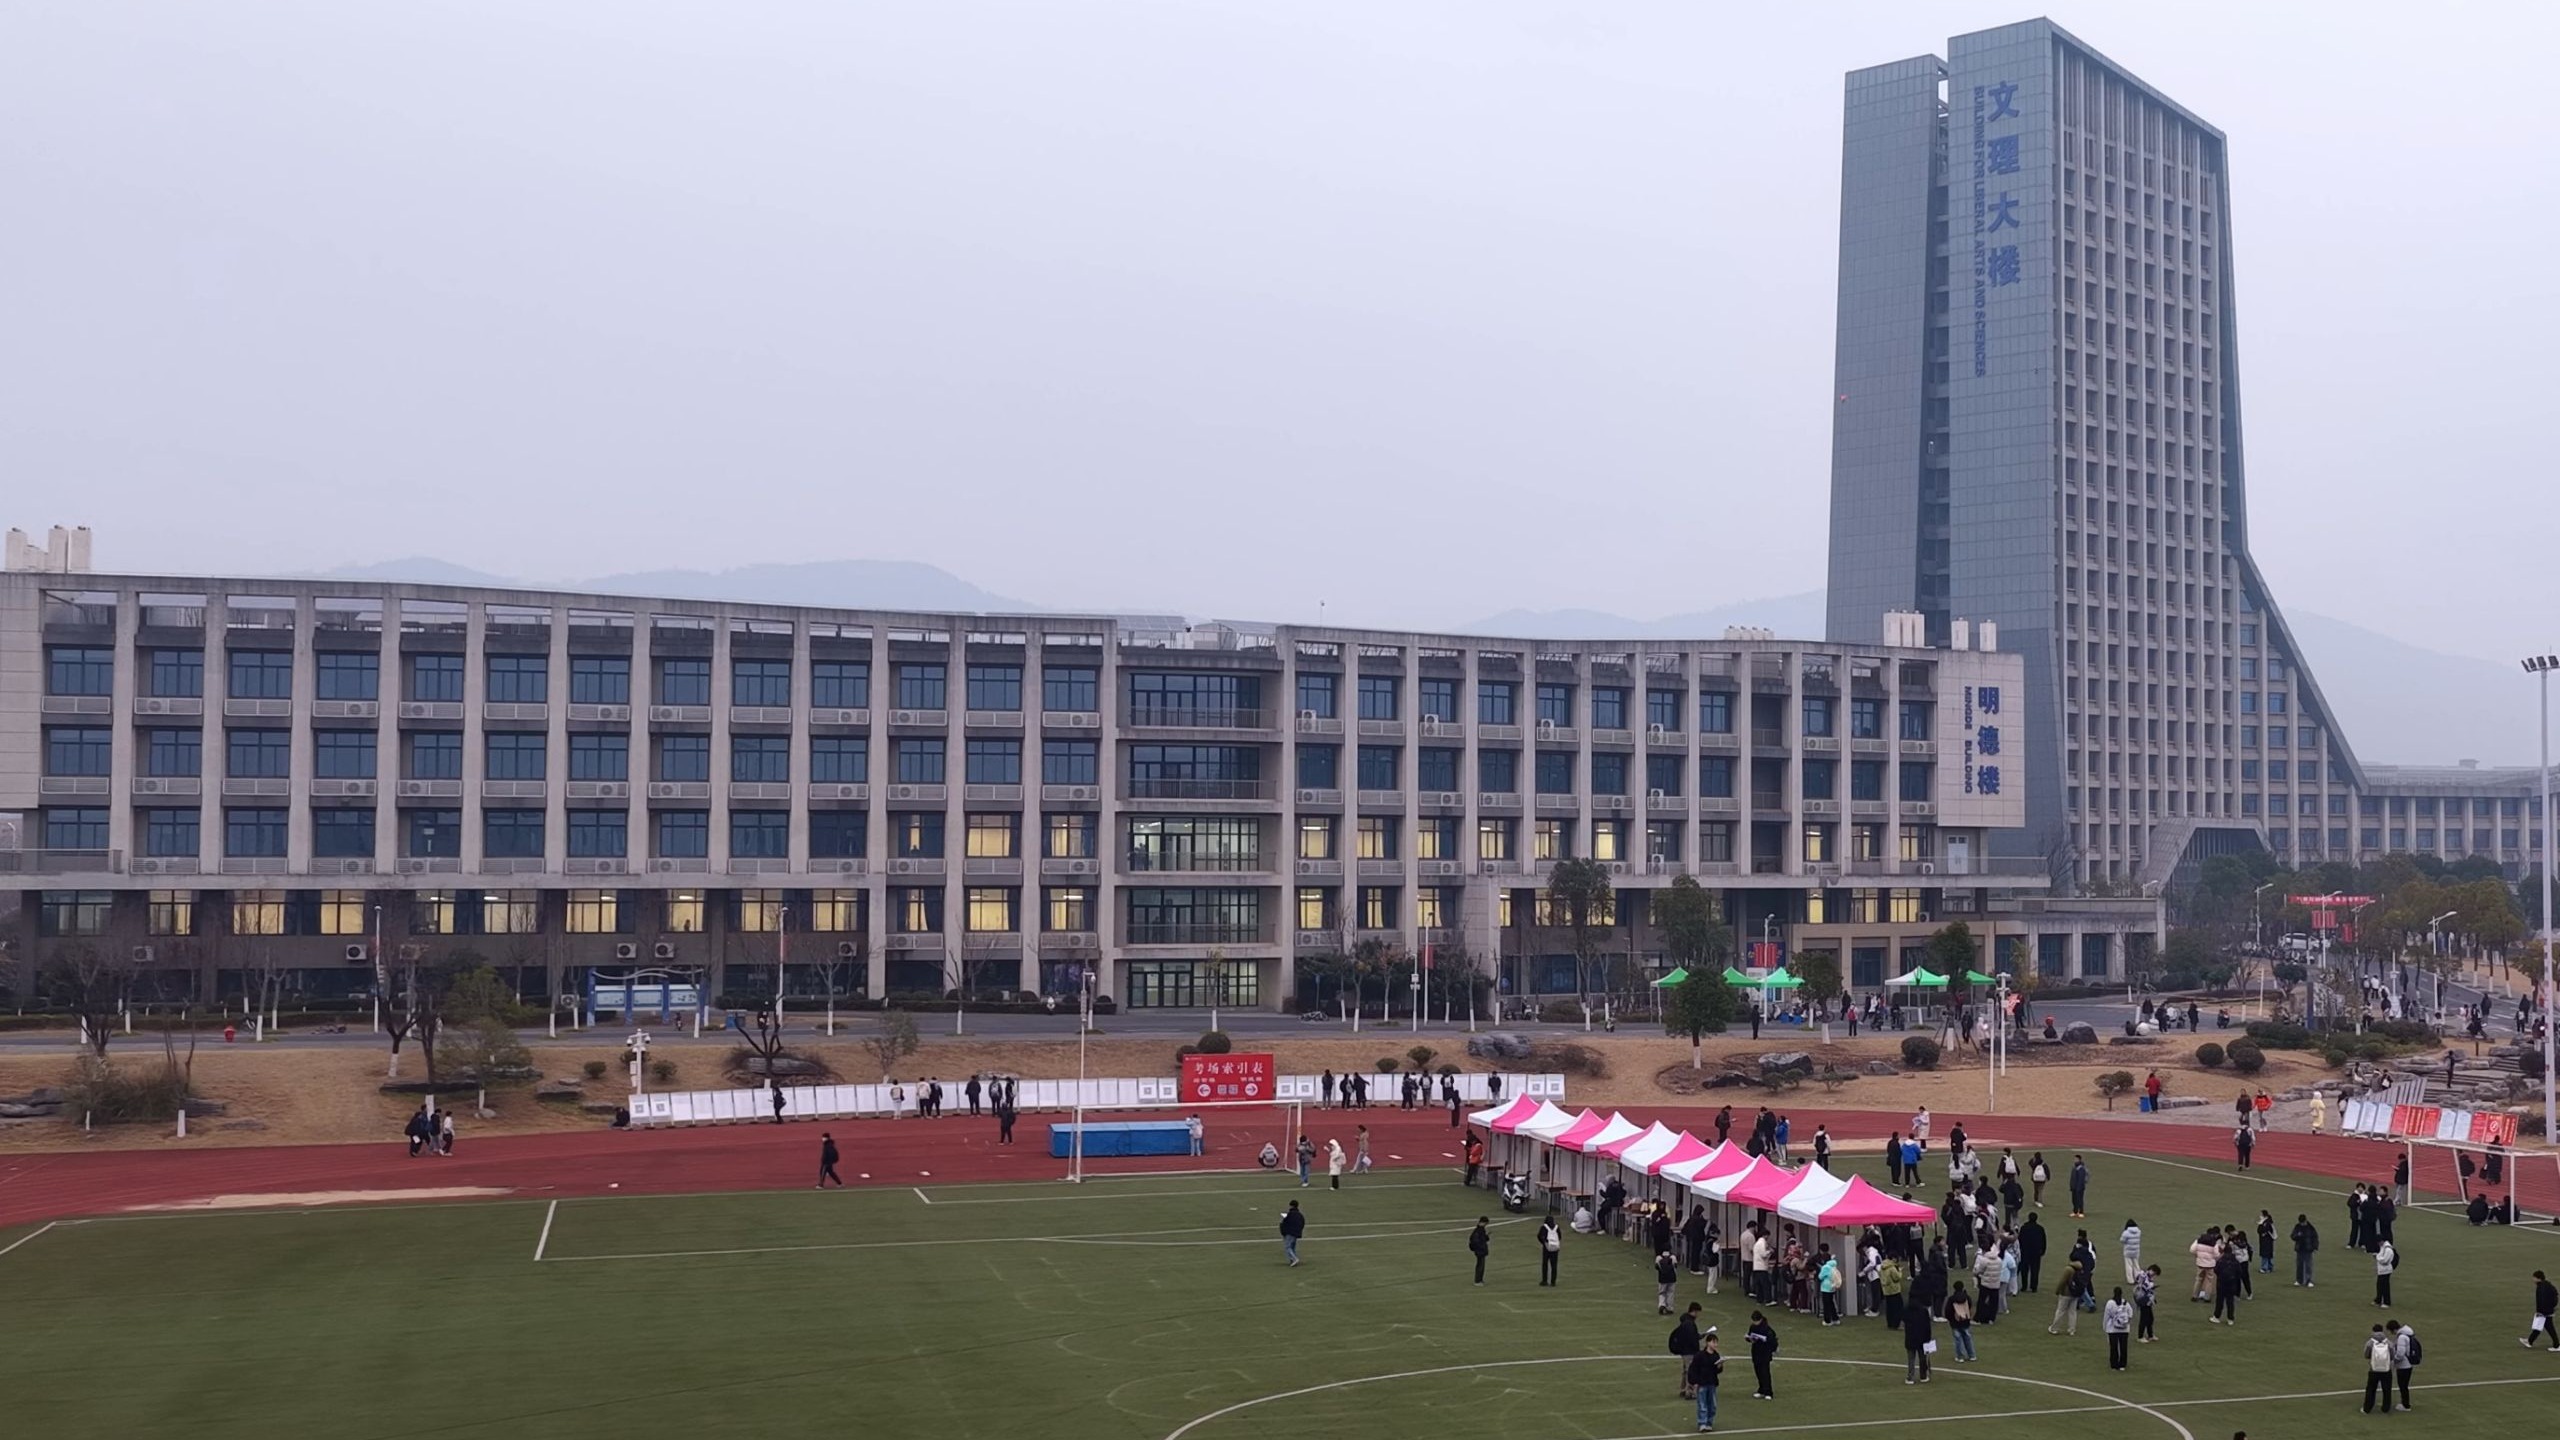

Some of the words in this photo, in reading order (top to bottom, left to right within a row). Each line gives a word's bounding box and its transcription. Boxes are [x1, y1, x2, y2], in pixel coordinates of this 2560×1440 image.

[1974, 86, 1985, 149] BUILDING
[1974, 150, 1985, 178] FOR
[1988, 80, 2021, 288] 文理大楼
[1974, 182, 1985, 236] LIBERAL
[1974, 240, 1986, 277] ARTS
[1974, 280, 1986, 308] AND
[1974, 311, 1986, 378] SCIENCES
[1965, 686, 1973, 730] MINGDE
[1965, 740, 1973, 794] BUILDING
[1977, 686, 2000, 795] 明德楼
[1194, 1061, 1264, 1075] 考场索引表
